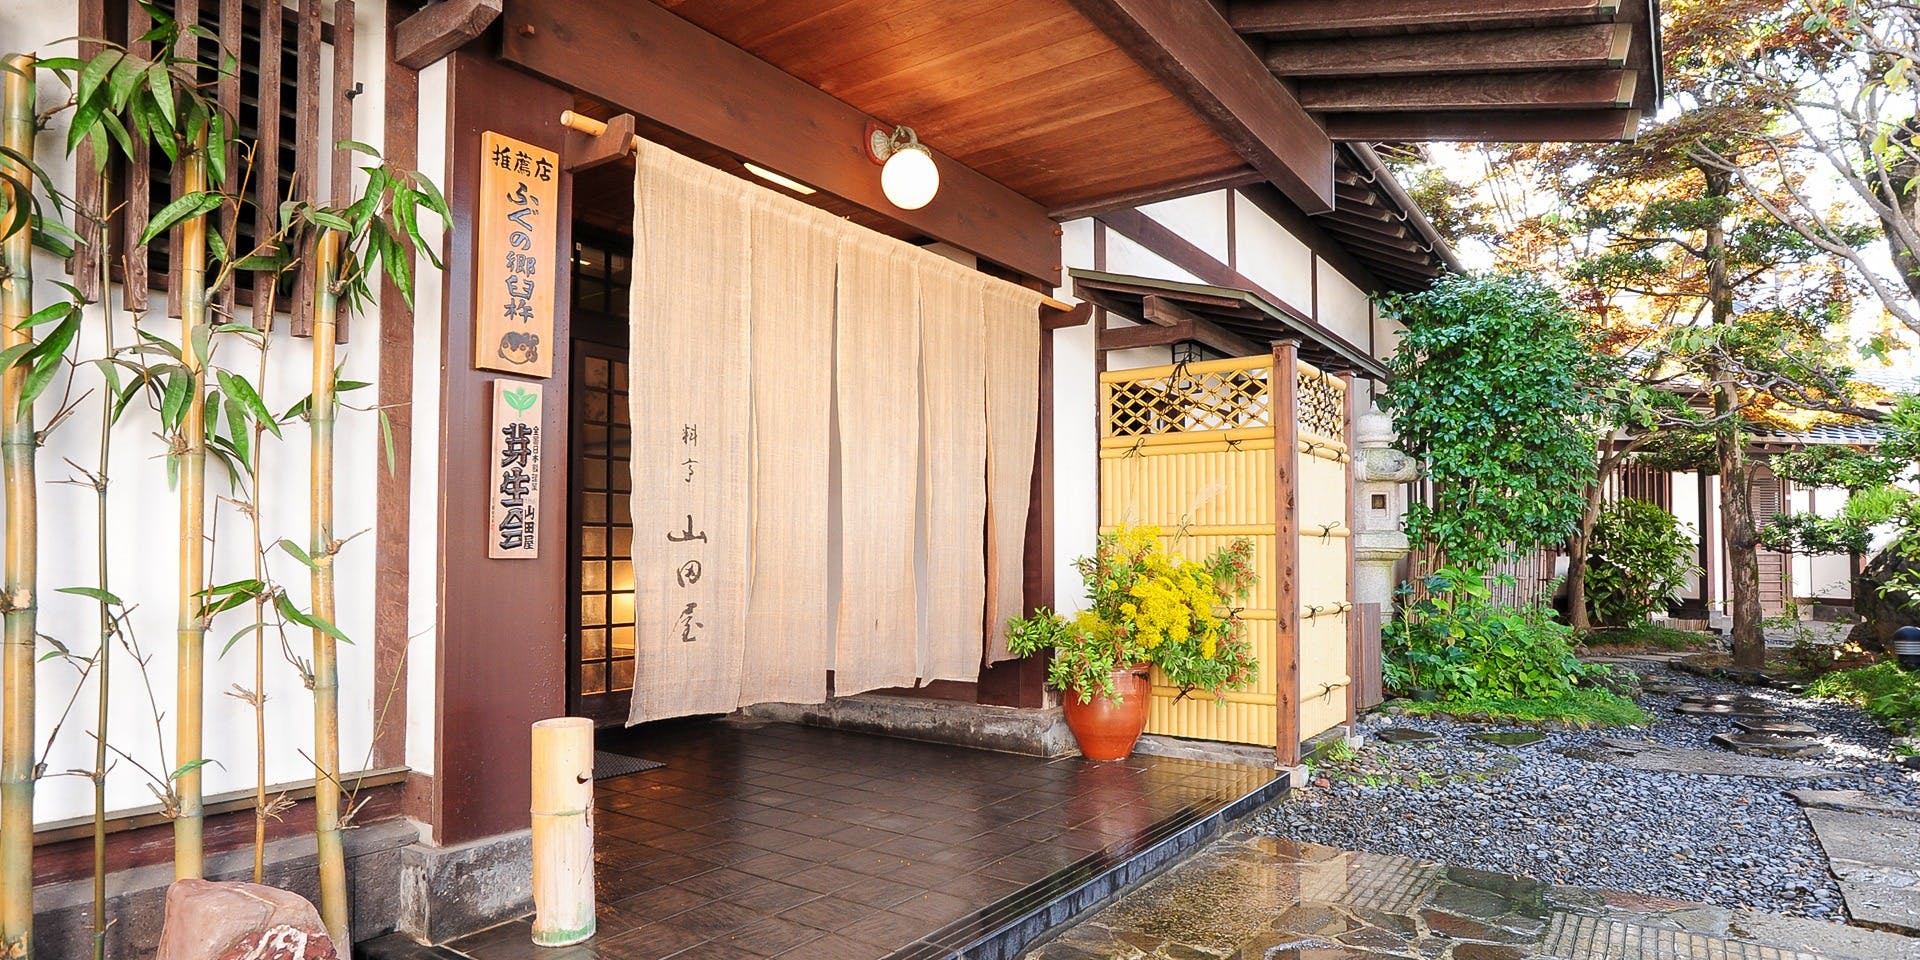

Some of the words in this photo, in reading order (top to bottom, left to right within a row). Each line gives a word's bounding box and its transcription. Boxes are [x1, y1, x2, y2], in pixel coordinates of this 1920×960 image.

[491, 144, 554, 182] 推薦店
[503, 181, 539, 324] ふぐの郷臼杵
[499, 422, 533, 550] 芽生会
[523, 505, 535, 550] 山田屋
[666, 514, 708, 643] 山田屋
